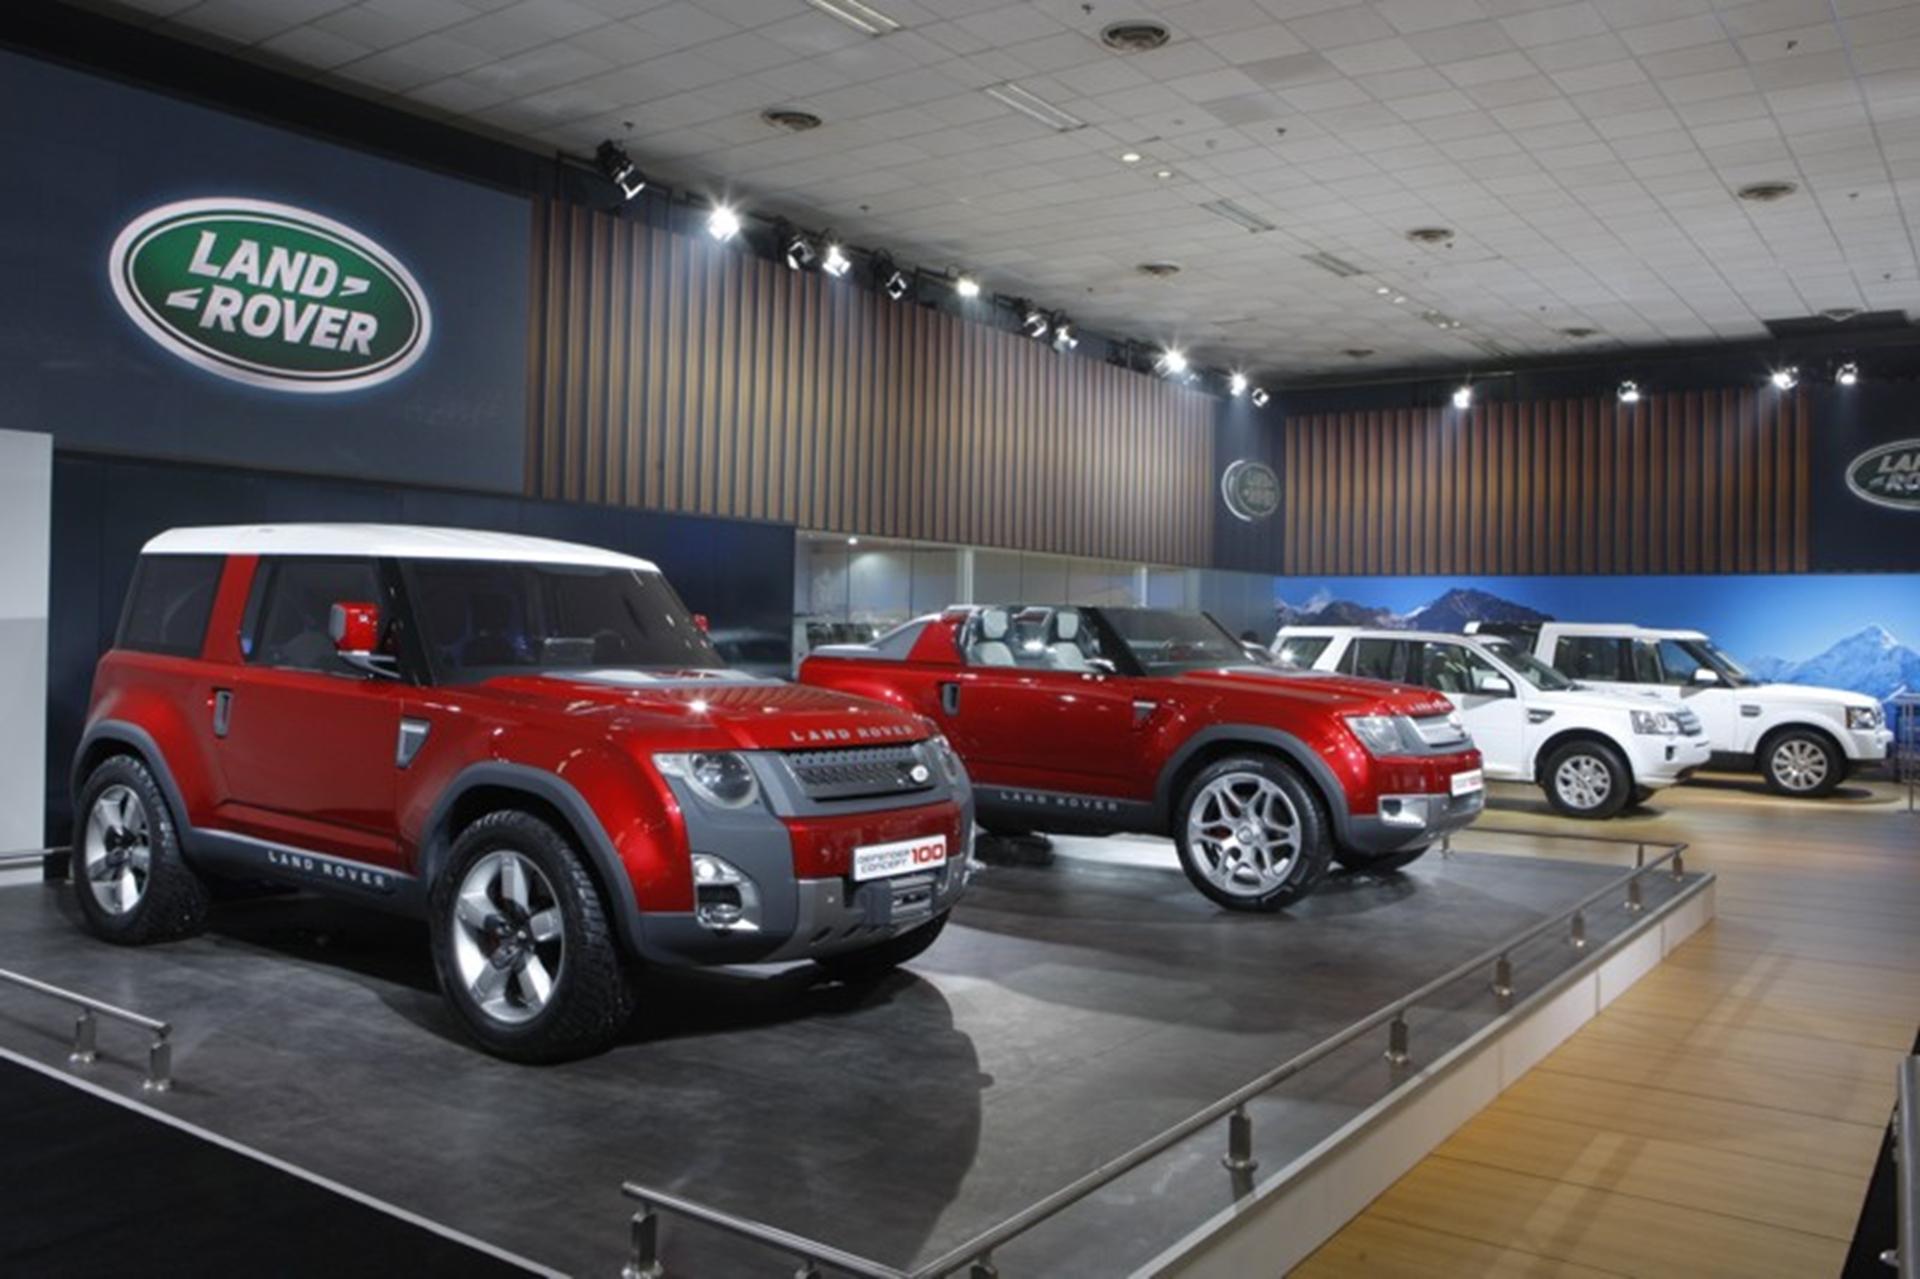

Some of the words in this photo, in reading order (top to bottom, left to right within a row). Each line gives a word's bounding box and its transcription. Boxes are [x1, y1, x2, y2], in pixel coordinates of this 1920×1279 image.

[188, 230, 339, 298] LAND
[199, 285, 379, 356] ROVER
[790, 729, 851, 742] LAND
[857, 724, 913, 739] ROVER
[1000, 791, 1046, 804] LAND
[911, 843, 944, 864] 100
[267, 850, 314, 871] LAND
[322, 863, 386, 887] ROVER
